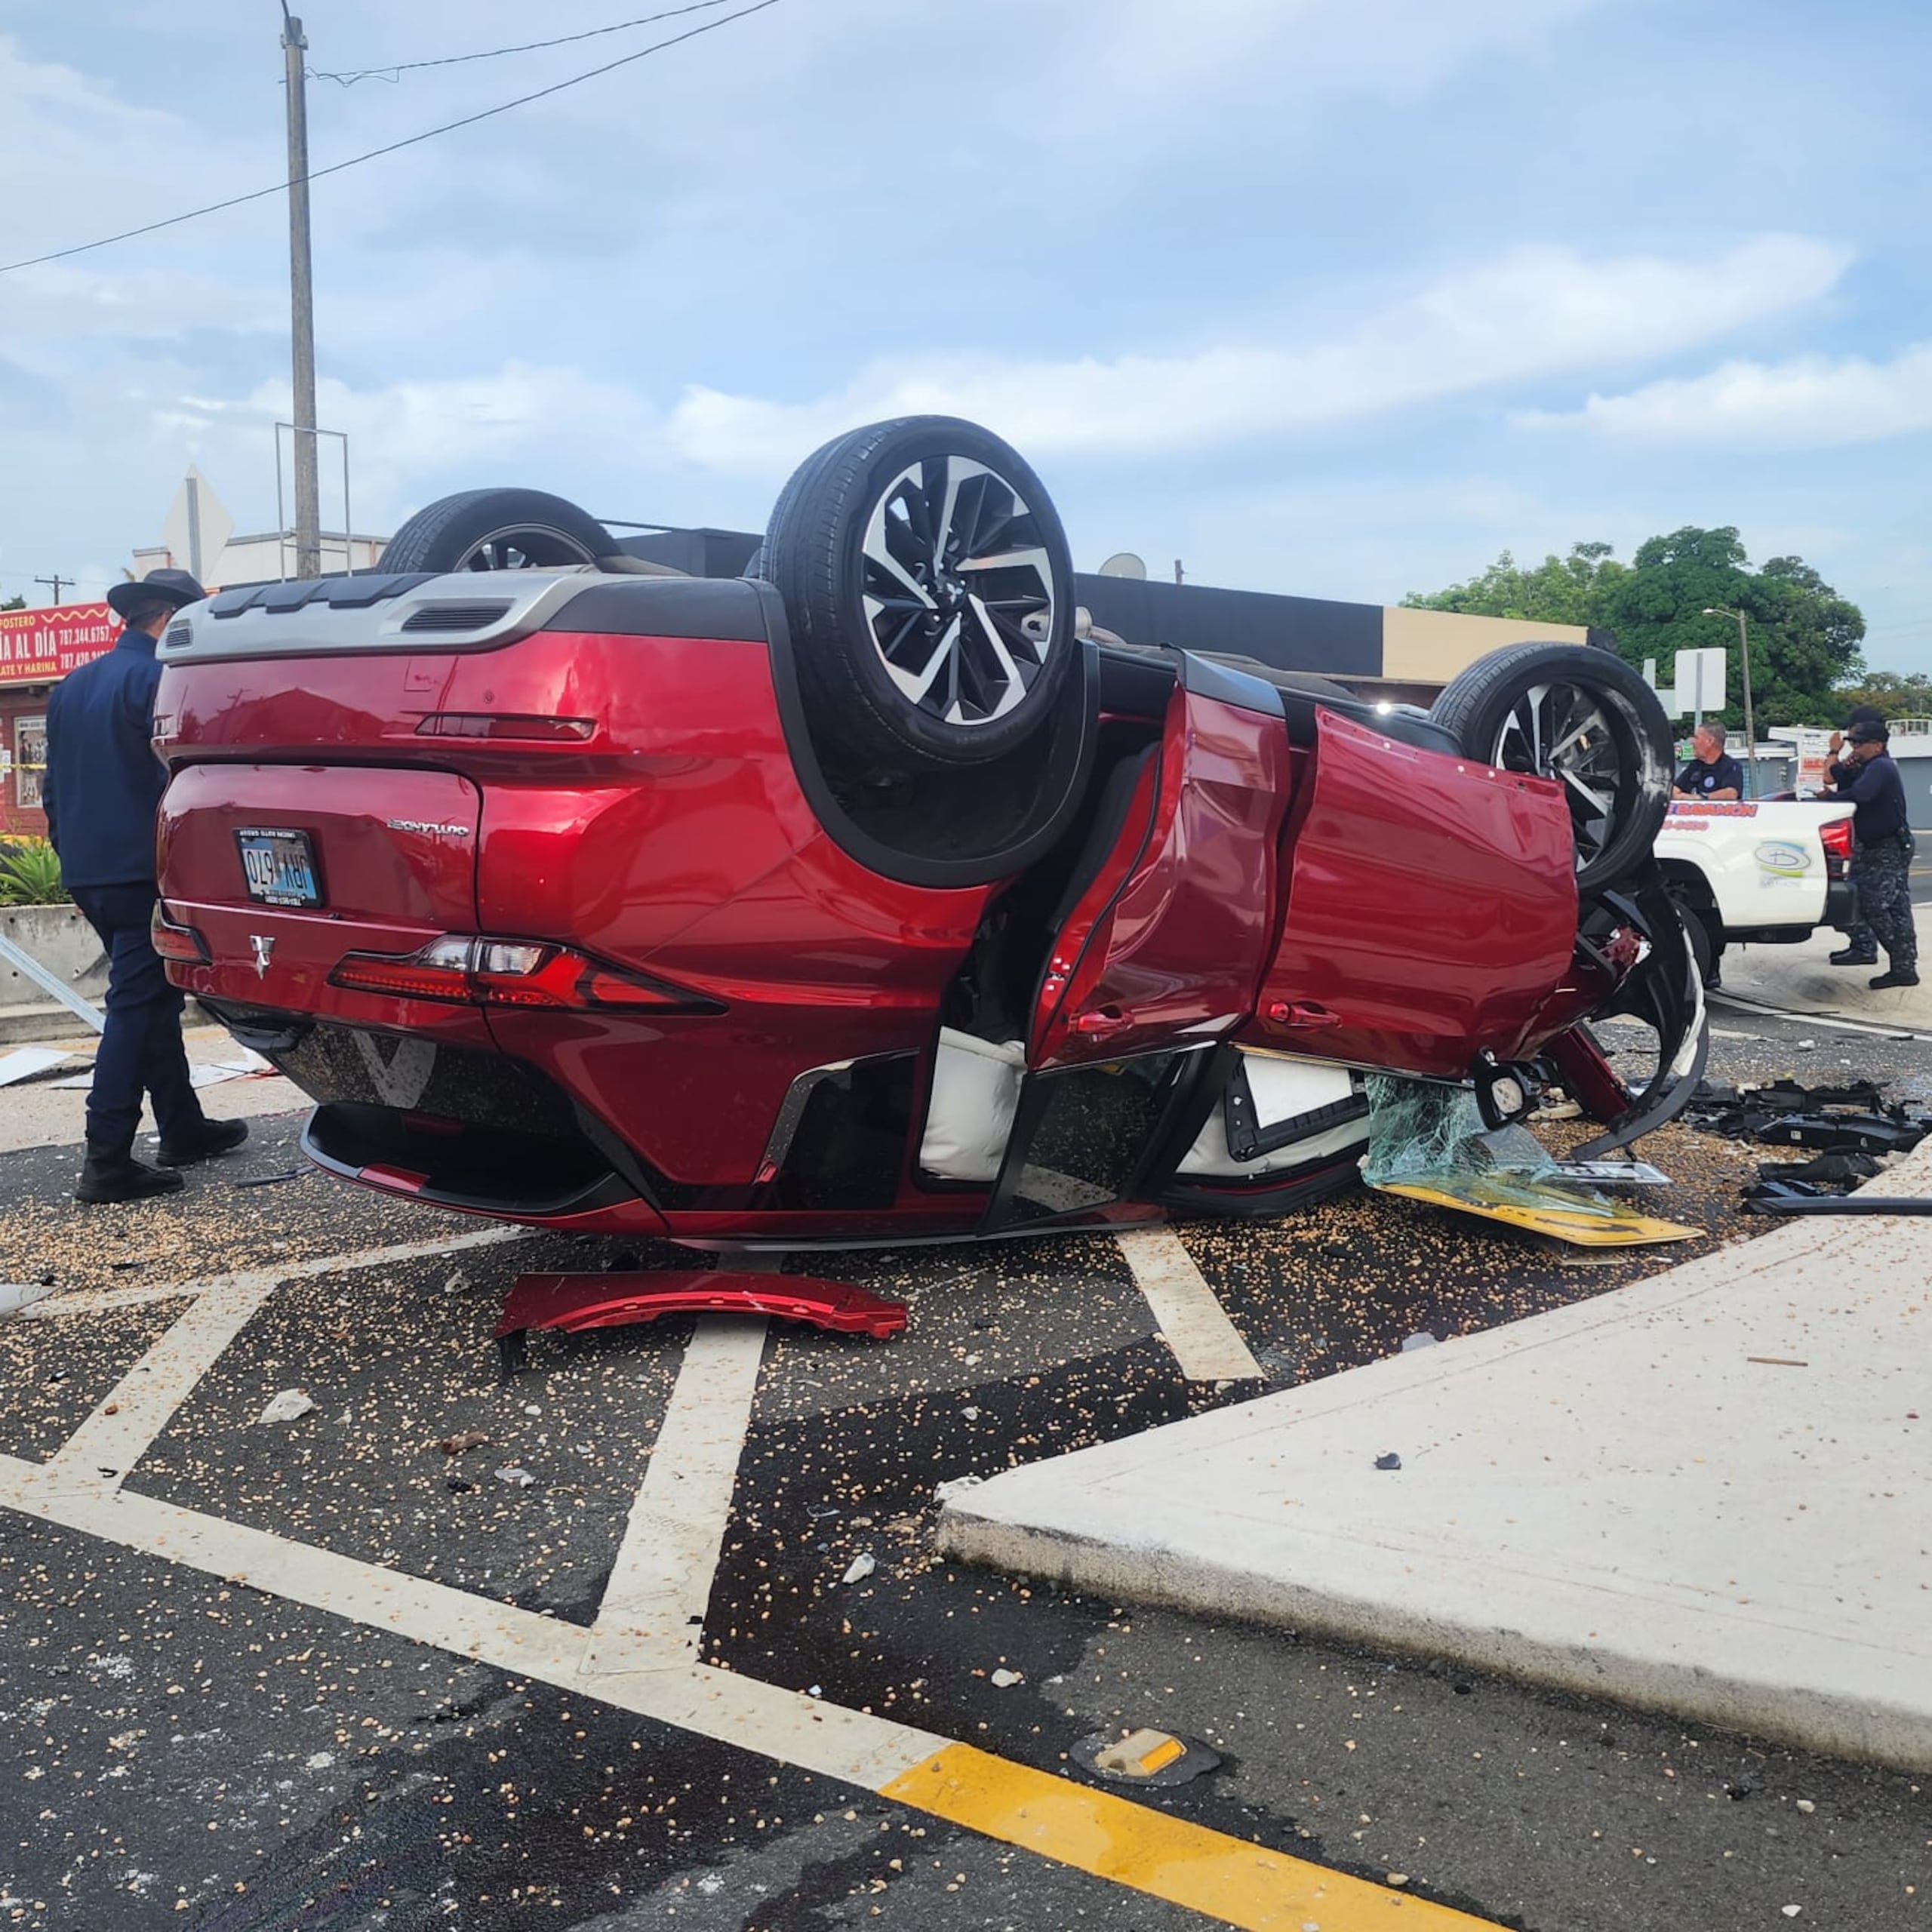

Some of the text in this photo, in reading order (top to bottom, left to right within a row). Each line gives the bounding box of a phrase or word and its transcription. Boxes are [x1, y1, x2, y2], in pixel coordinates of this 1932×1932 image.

[16, 632, 31, 660] AL
[35, 626, 57, 657] DÍA
[17, 663, 23, 675] Y
[24, 661, 57, 674] HARINA
[247, 851, 274, 885] 670
